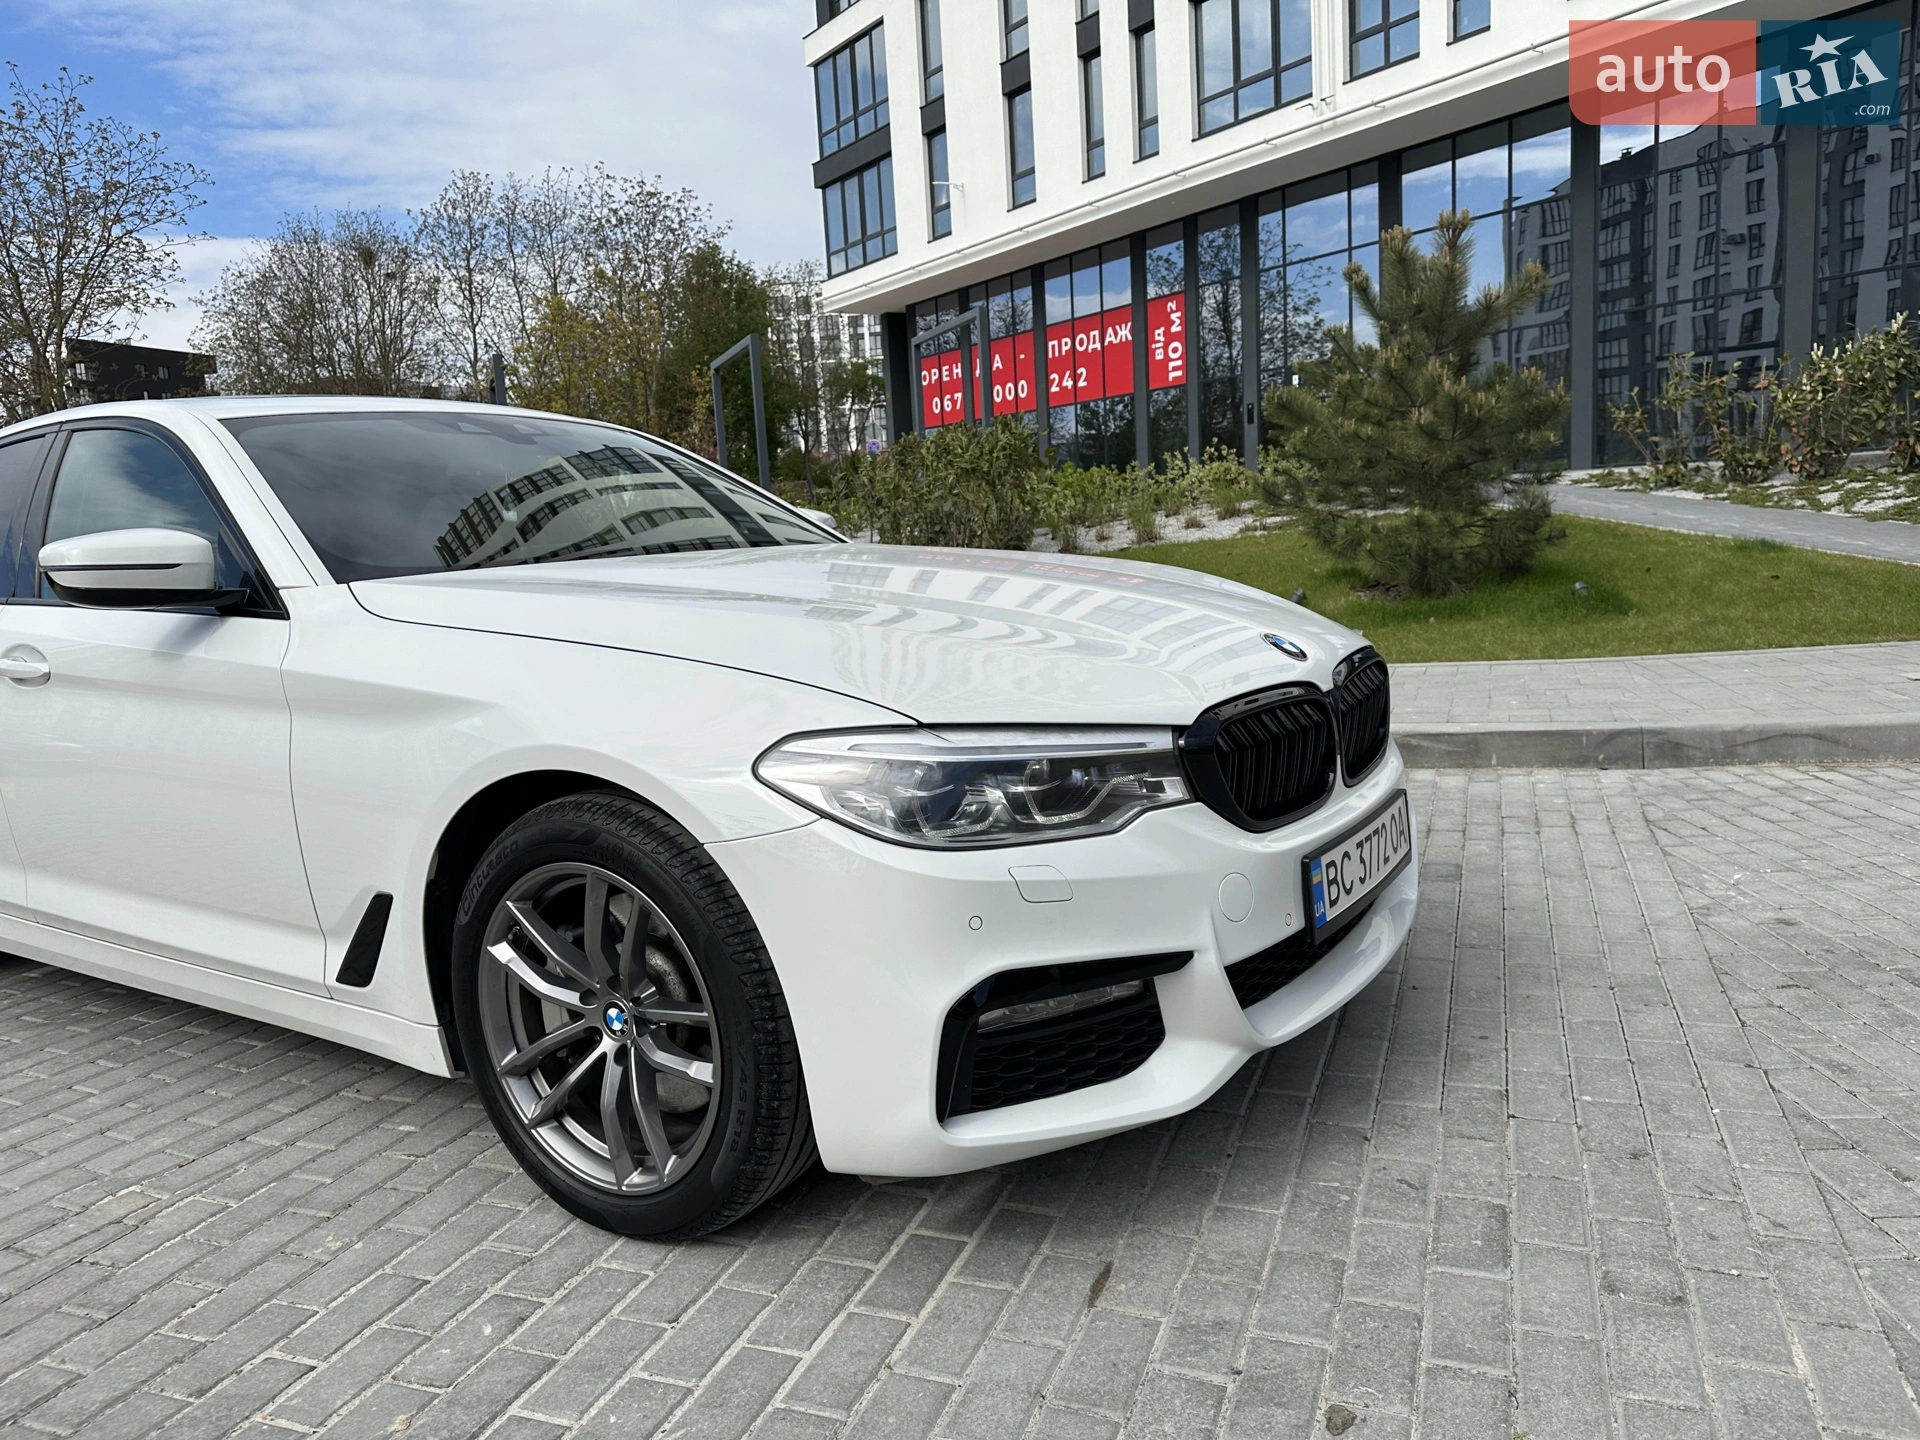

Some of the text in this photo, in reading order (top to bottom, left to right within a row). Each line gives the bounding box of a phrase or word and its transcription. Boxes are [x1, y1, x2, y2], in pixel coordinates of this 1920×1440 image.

[1048, 321, 1133, 359] ПРОДАЖ
[1152, 326, 1165, 360] від
[1168, 341, 1183, 381] 110
[932, 392, 963, 414] 067
[1049, 367, 1088, 393] 242
[1325, 806, 1408, 909] BC 3772 OA
[1314, 902, 1325, 917] UA
